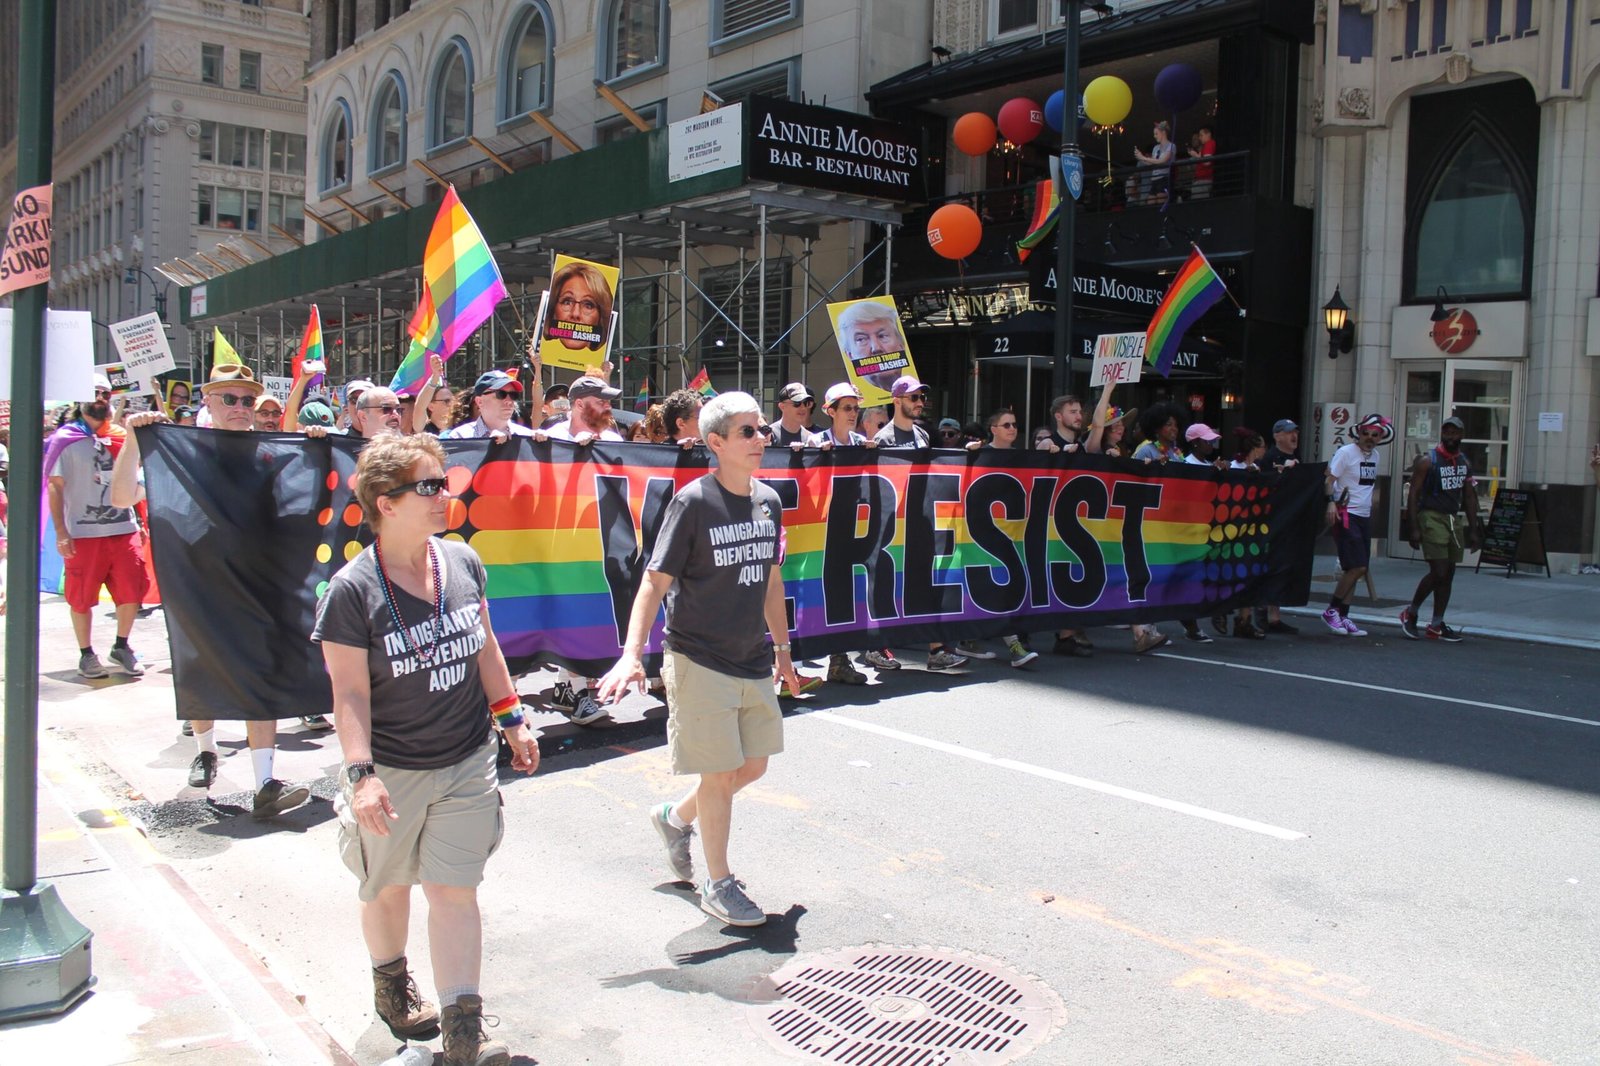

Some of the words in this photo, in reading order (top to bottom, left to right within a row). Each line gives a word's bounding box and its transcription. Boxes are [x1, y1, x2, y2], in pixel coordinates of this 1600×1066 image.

[693, 120, 710, 132] MADISON
[710, 116, 723, 127] AVENUE
[769, 147, 803, 169] BAR
[815, 156, 910, 186] RESTAURANT
[12, 194, 39, 222] NO
[1044, 267, 1097, 296] ANIE
[557, 321, 575, 330] BETSY
[575, 323, 593, 332] DEVOS
[994, 337, 1009, 353] 22
[859, 356, 882, 367] DONALD
[881, 352, 901, 362] TRUMP
[266, 381, 280, 390] NO
[1440, 465, 1456, 477] RISE
[823, 472, 1164, 628] RESIST
[429, 662, 467, 693] AQUI
